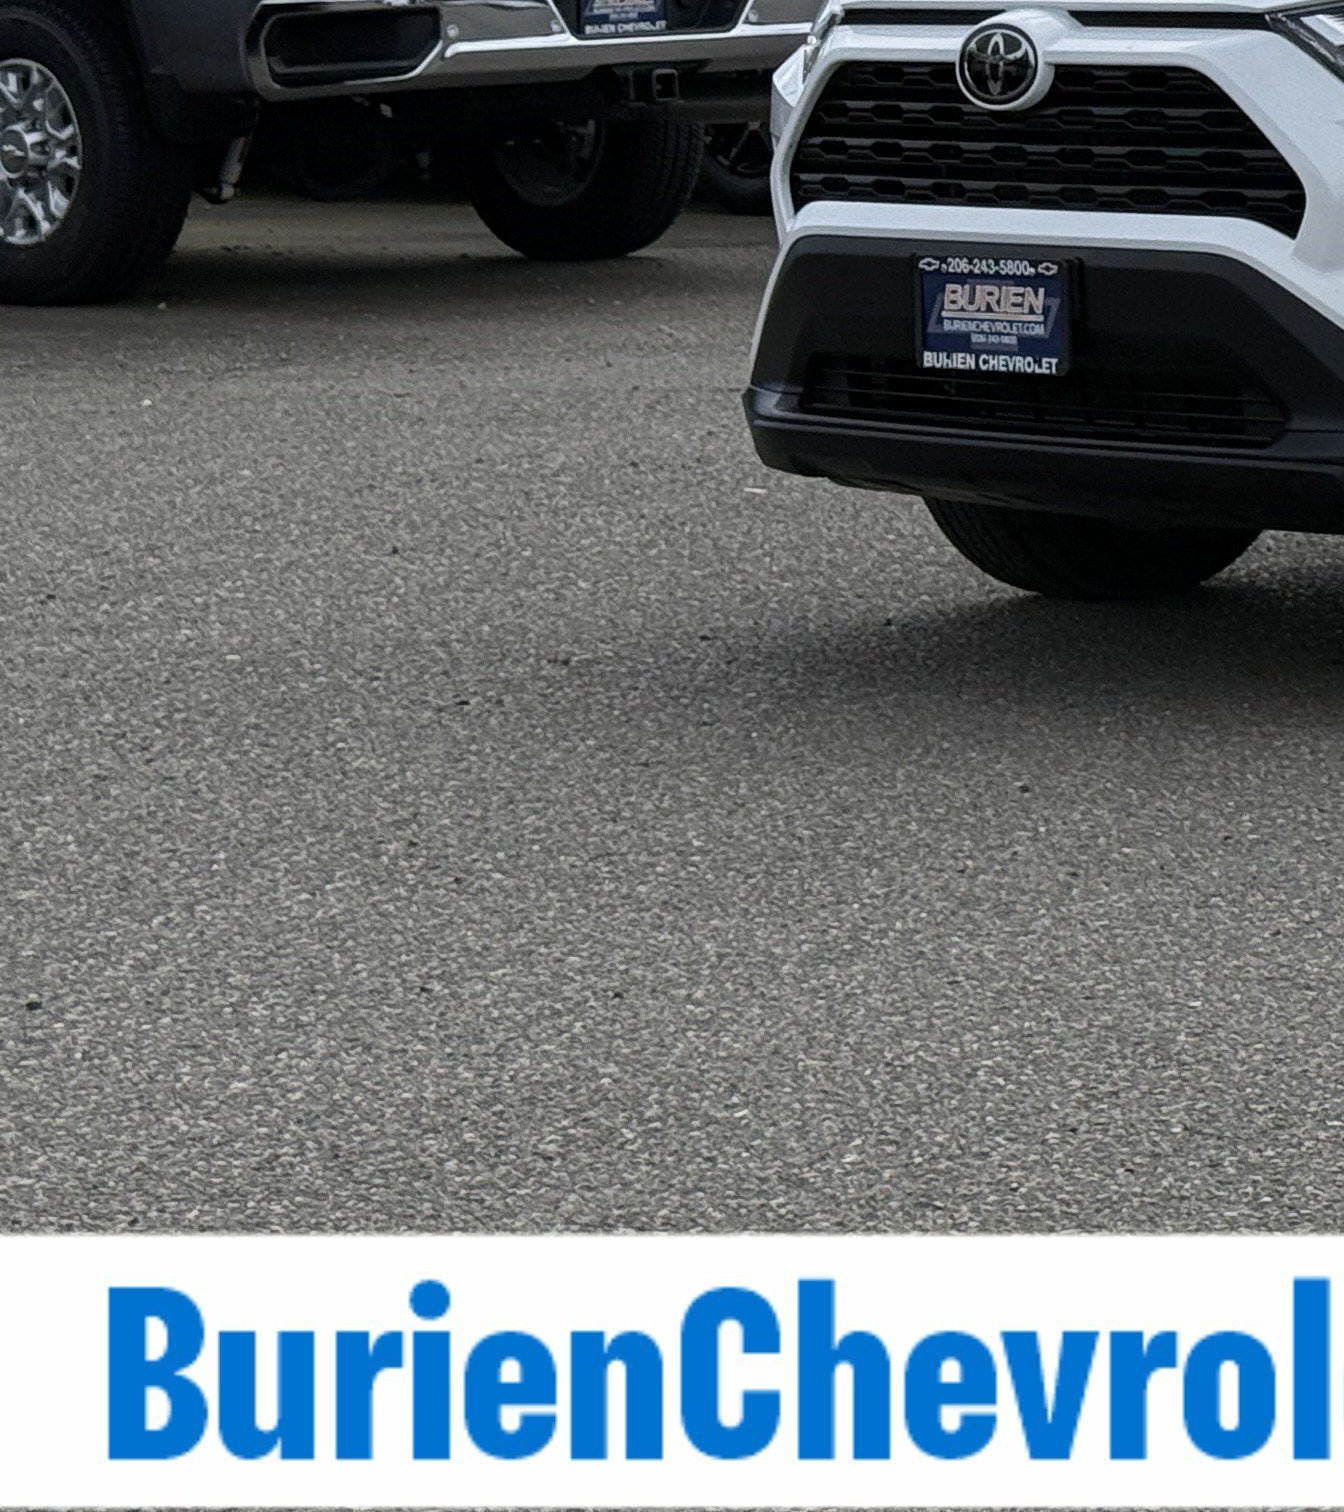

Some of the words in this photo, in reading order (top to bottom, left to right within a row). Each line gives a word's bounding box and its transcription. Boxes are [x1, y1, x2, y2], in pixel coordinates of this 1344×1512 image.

[948, 257, 1030, 276] 206-243-5800
[944, 283, 1045, 313] BURIEN
[922, 350, 976, 371] BURIEN
[978, 352, 1059, 375] CHEVROLET
